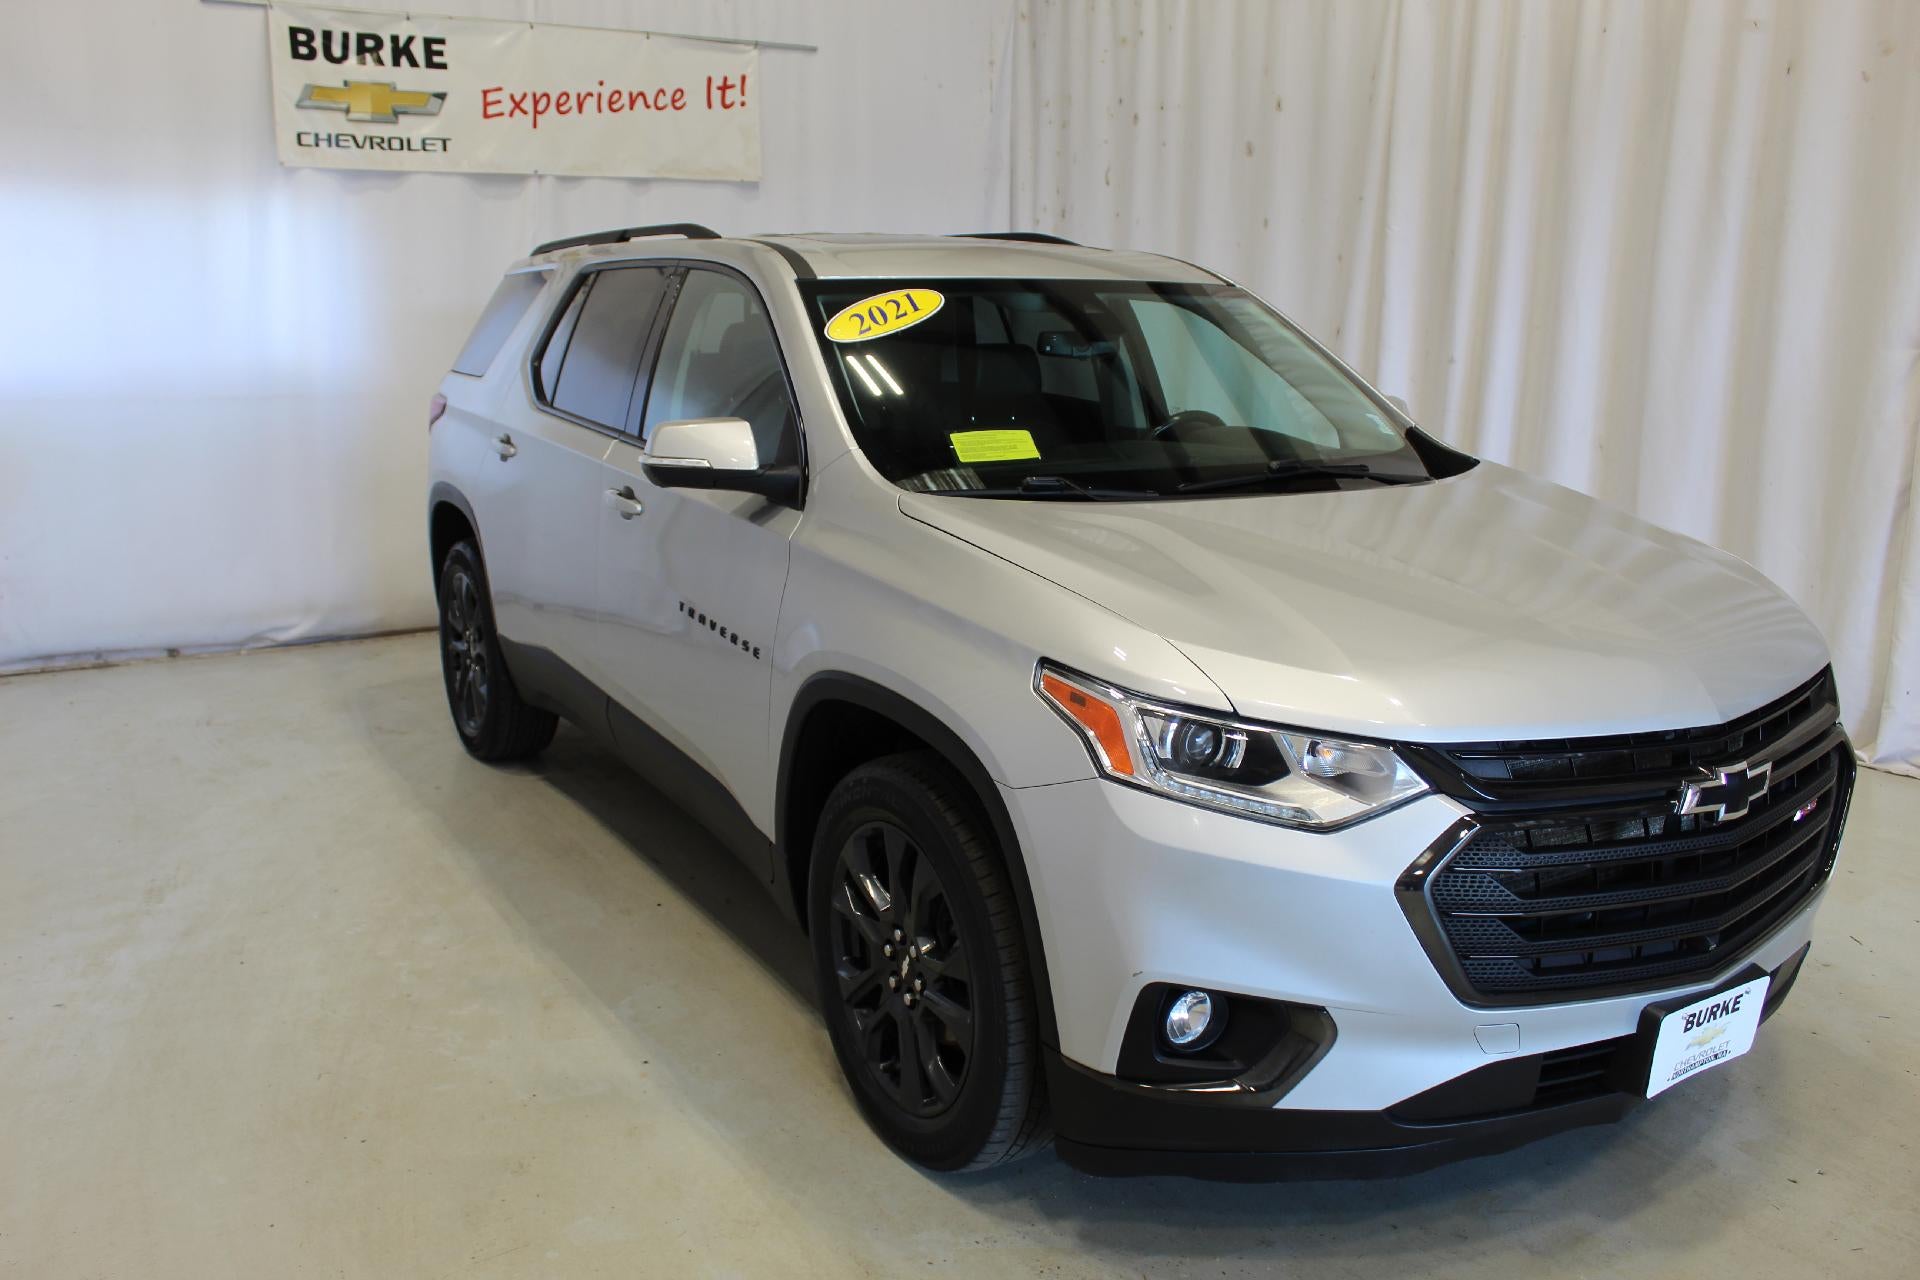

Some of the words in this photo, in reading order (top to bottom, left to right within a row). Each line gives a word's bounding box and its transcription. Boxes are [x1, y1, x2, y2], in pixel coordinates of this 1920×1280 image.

[288, 26, 448, 69] BURKE
[482, 80, 686, 129] Experience
[706, 74, 748, 109] It!
[296, 131, 452, 153] CHEVROLET
[849, 293, 921, 335] 2021
[679, 601, 760, 660] TRAVERSE
[1683, 993, 1744, 1033] BURKE
